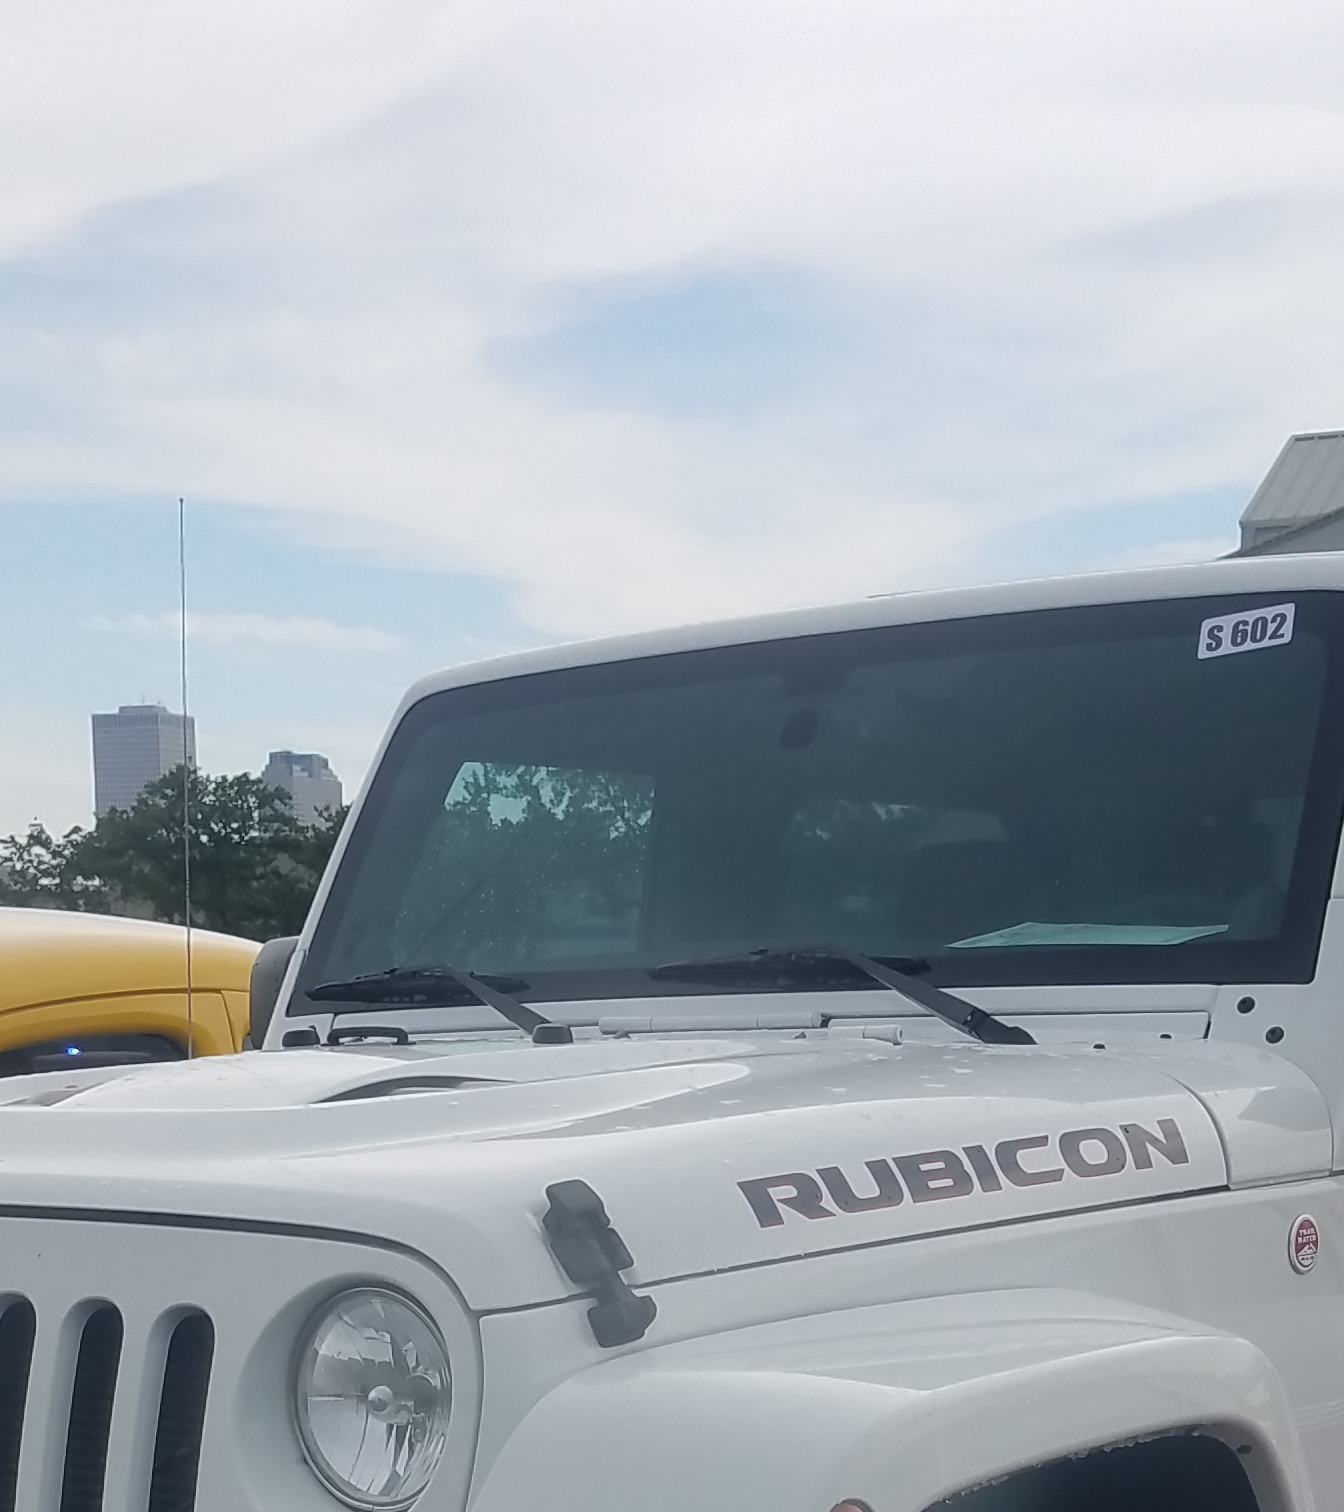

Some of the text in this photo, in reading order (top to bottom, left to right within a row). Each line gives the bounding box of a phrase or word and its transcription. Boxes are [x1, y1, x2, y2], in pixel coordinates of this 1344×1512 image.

[1205, 612, 1288, 652] S 602
[736, 1118, 1190, 1229] RUBICON
